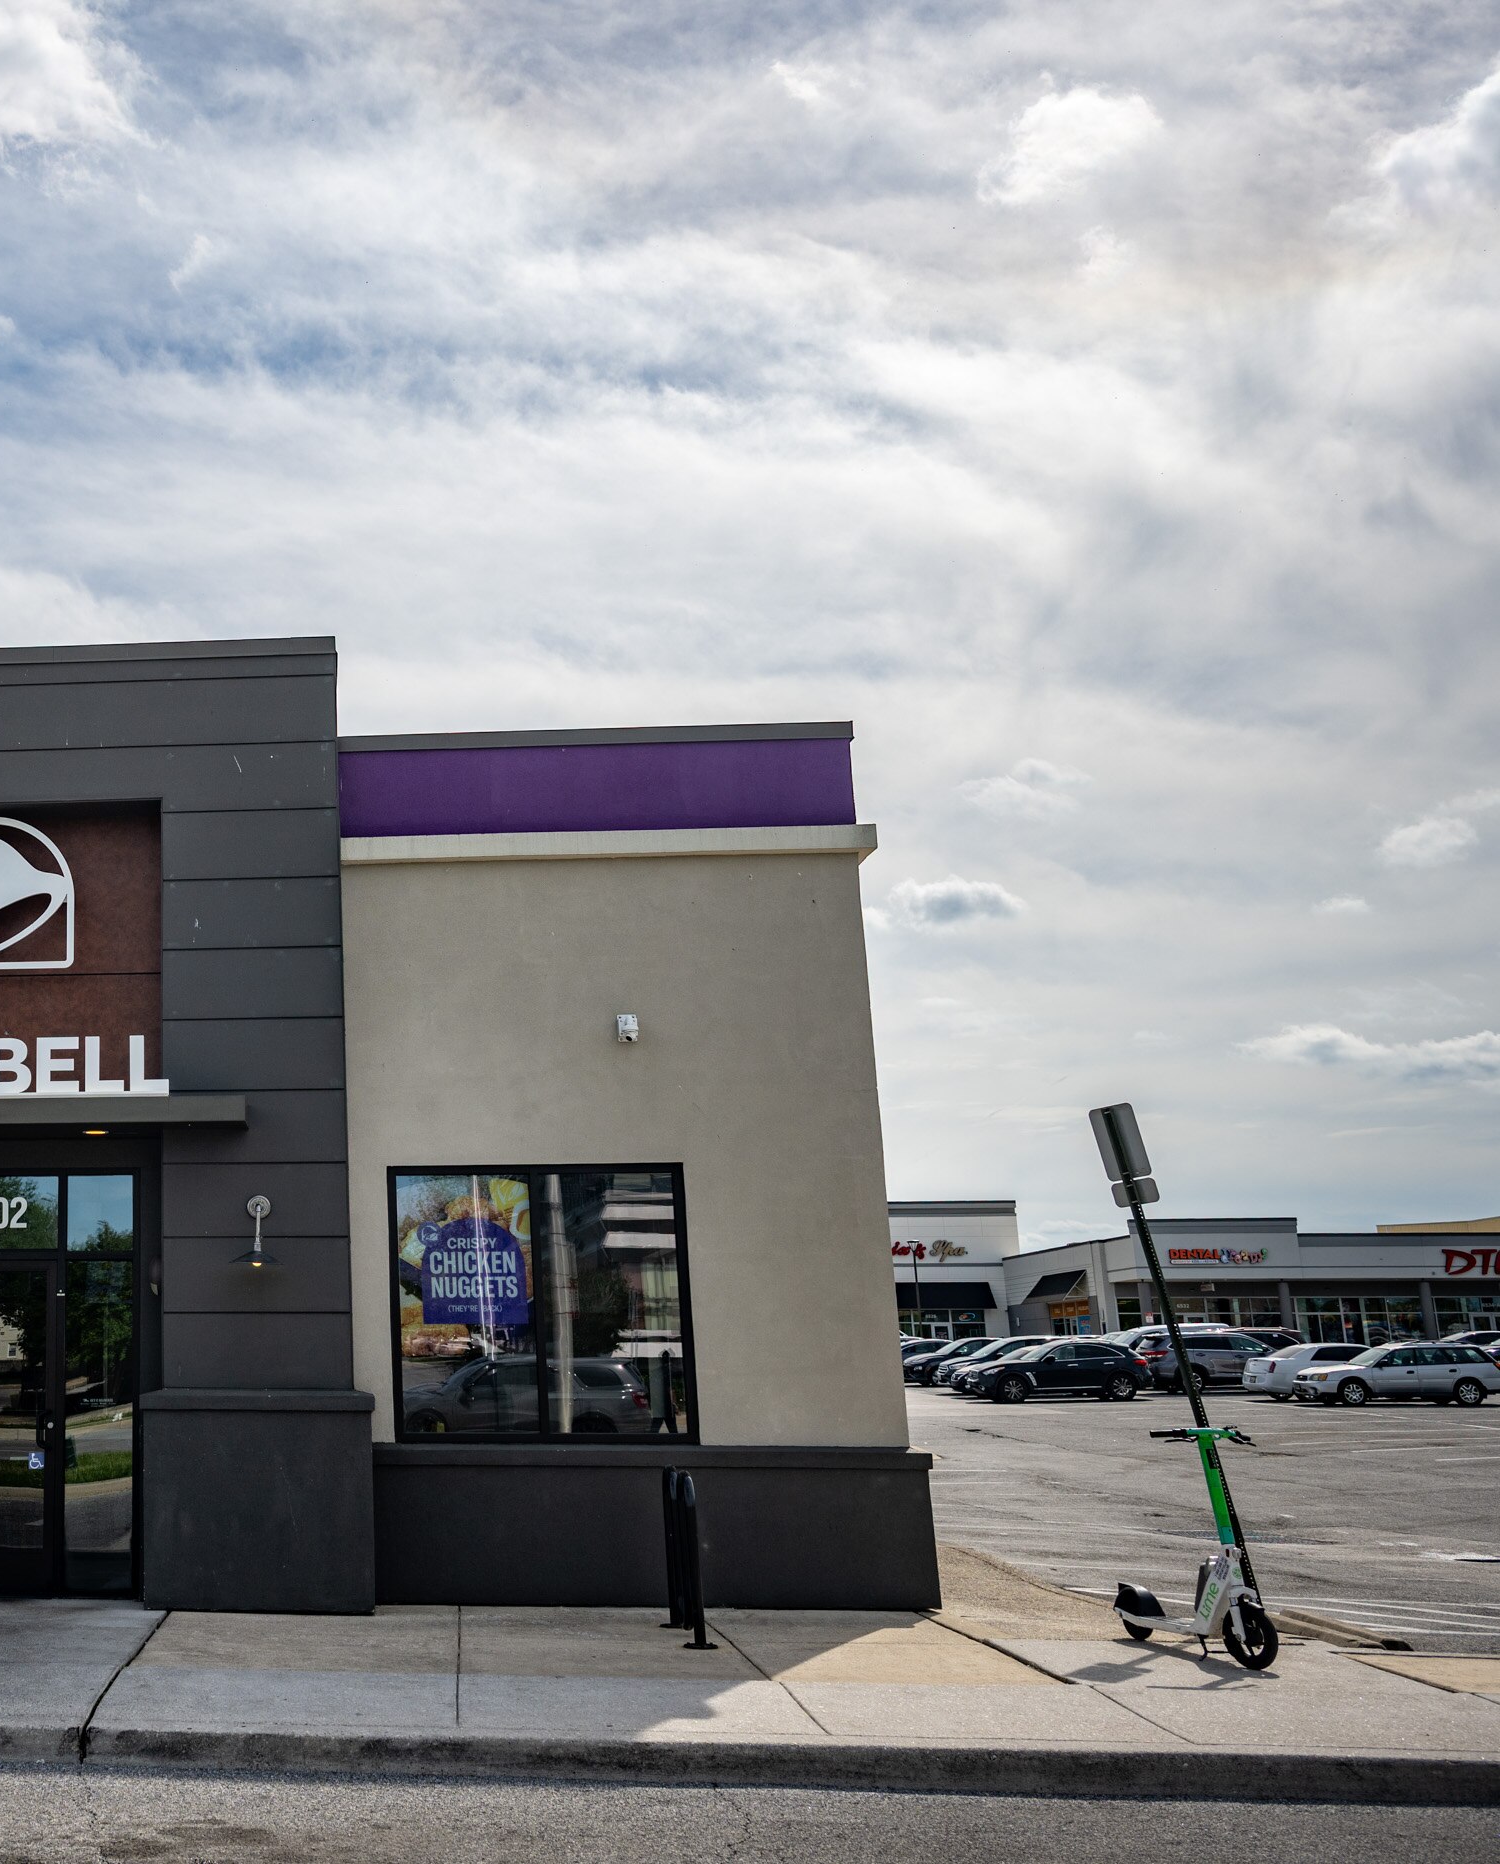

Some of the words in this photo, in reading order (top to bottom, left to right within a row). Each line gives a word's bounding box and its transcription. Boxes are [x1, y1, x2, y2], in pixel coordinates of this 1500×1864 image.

[446, 1237, 498, 1250] CRISPY
[1168, 1247, 1220, 1260] DENTAL
[429, 1250, 517, 1275] CHICKEN
[431, 1275, 518, 1299] NUGGETS
[447, 1304, 478, 1313] (THEY'RE
[482, 1304, 503, 1313] BACK)
